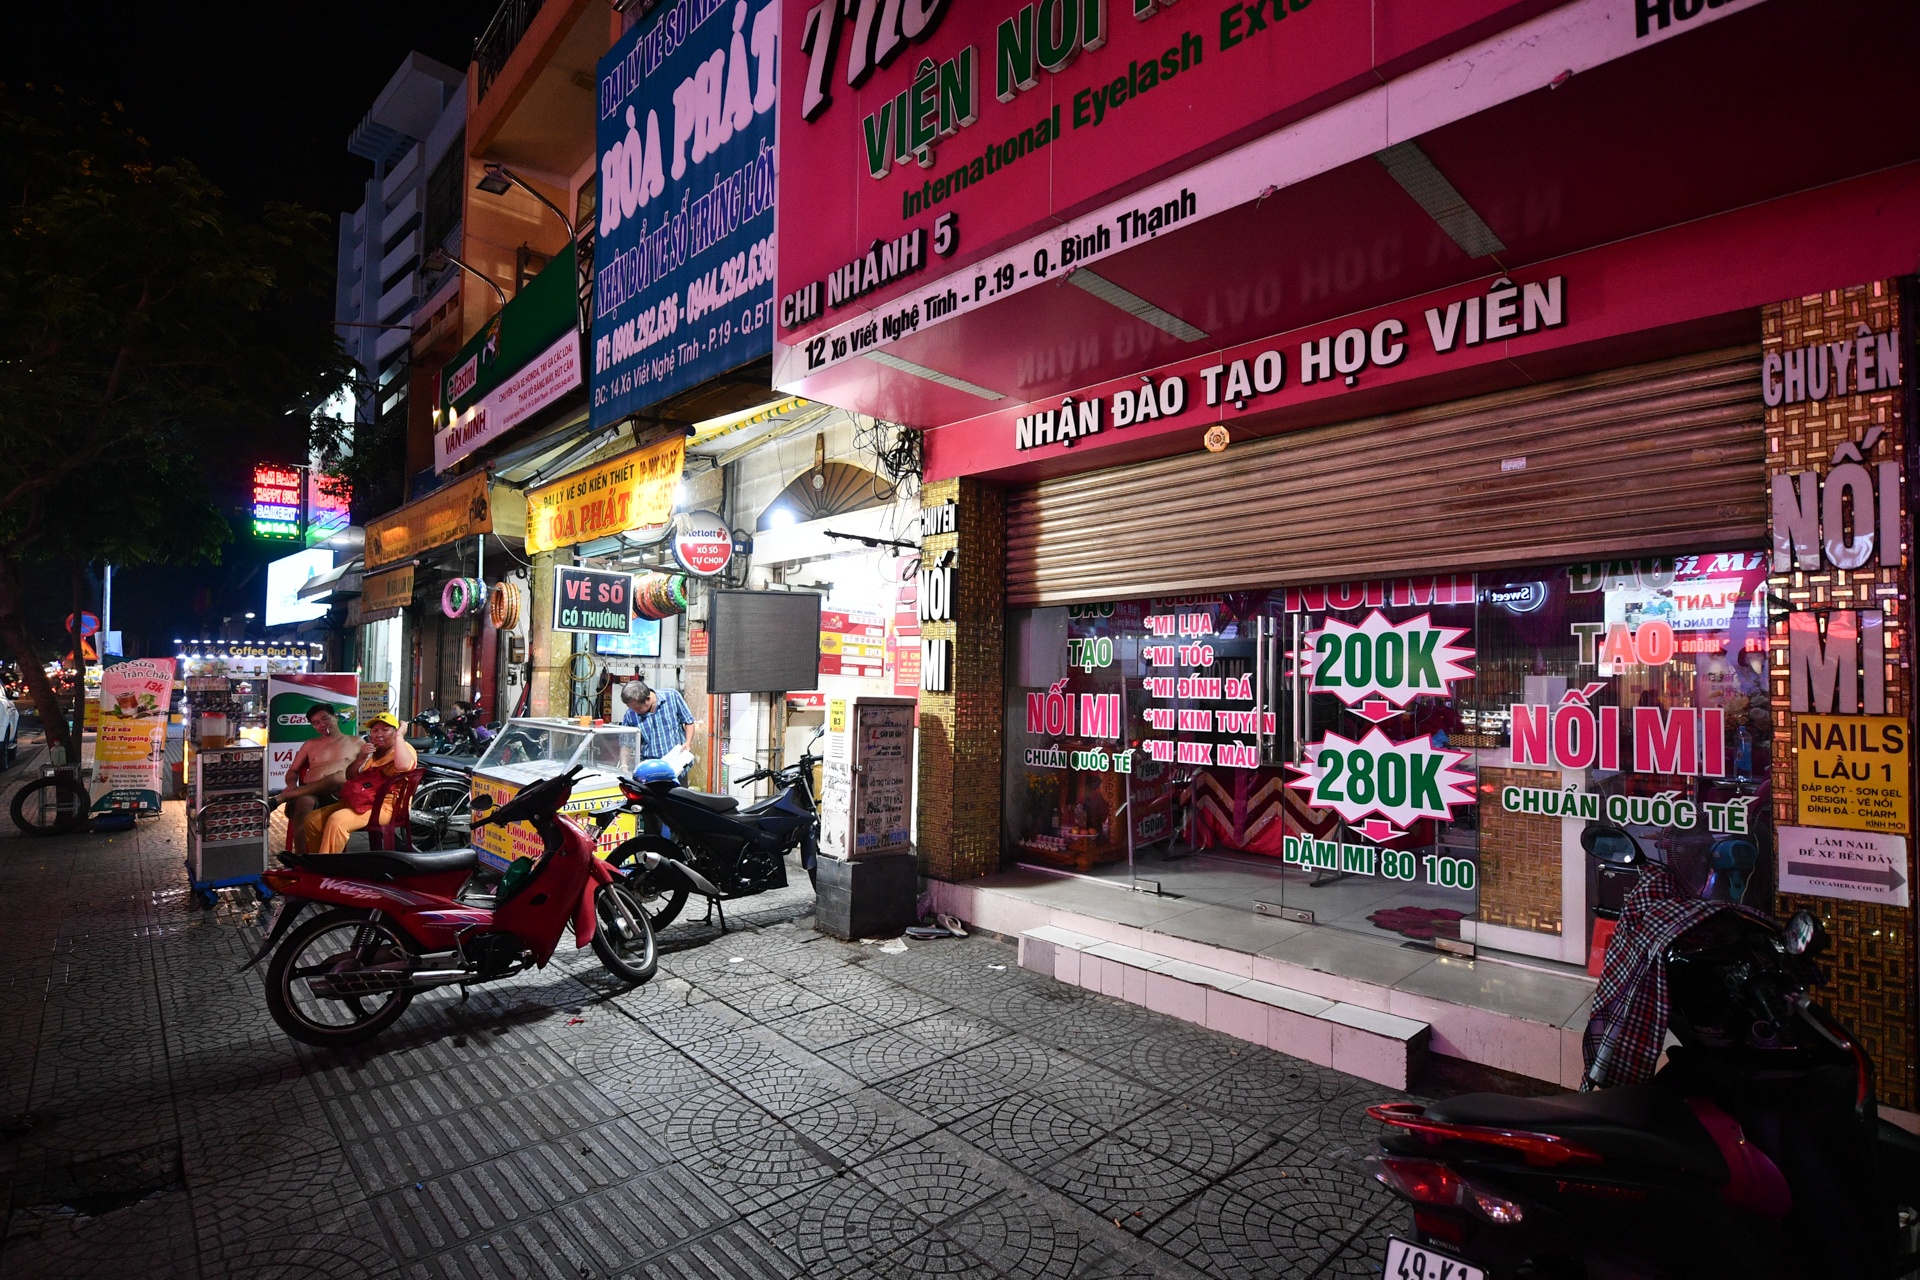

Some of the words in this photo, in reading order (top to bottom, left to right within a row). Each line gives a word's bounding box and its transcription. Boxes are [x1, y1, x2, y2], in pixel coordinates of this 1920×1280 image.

[602, 61, 624, 120] ĐẠI
[626, 36, 643, 97] LÝ
[645, 13, 664, 78] VÉ
[671, 0, 776, 181] PHÁT
[863, 45, 978, 179] VIỆN
[902, 104, 1060, 220] International
[1073, 31, 1203, 130] Eyelash
[597, 248, 629, 320] NHẬN
[652, 210, 670, 283] VÉ
[670, 187, 690, 272] SỐ
[780, 280, 824, 329] CHI
[827, 228, 926, 309] NHÁNH
[933, 211, 959, 257] 5
[804, 337, 826, 370] 12
[831, 335, 847, 361] Xô
[849, 318, 878, 349] Viết
[882, 304, 920, 338] Nghệ
[923, 289, 958, 322] Tĩnh
[974, 265, 1015, 302] P.19
[1117, 188, 1197, 237] Thạnh
[594, 384, 608, 407] ĐC:
[610, 379, 619, 399] 14
[620, 371, 632, 395] Xô
[633, 357, 649, 388] Viết
[651, 349, 676, 383] Nghệ
[677, 337, 699, 367] Tĩnh
[708, 319, 731, 352] P.19
[741, 297, 774, 335] Q.BT
[1015, 397, 1100, 451] NHẬN
[1111, 375, 1184, 428] ĐÀO
[1200, 350, 1284, 410] TẠO
[1301, 319, 1405, 386] HỌC
[1425, 276, 1566, 352] VIÊN
[1762, 323, 1900, 407] CHUYÊN
[454, 359, 476, 398] Castrol
[577, 475, 587, 496] SỐ
[589, 469, 607, 492] KIẾN
[610, 459, 635, 485] THIẾT
[256, 505, 296, 521] BAKERY
[579, 488, 631, 535] PHÁT
[1771, 425, 1900, 573] NỐI
[692, 556, 703, 565] TỰ
[704, 556, 723, 565] CHỌN
[566, 575, 591, 600] VÉ
[598, 579, 625, 604] SỐ
[917, 550, 951, 621] NỐI
[562, 605, 578, 626] CÓ
[582, 608, 626, 630] THƯỞNG
[1178, 613, 1213, 639] LỤA
[108, 662, 128, 673] Trà
[132, 660, 154, 669] Sữa
[229, 646, 264, 656] Coffee
[267, 647, 287, 656] And
[290, 647, 307, 656] Tea
[921, 639, 947, 691] MI
[1067, 636, 1114, 673] TẠO
[1179, 641, 1214, 667] TÓC
[1315, 630, 1442, 688] 200K
[1570, 621, 1675, 675] TẠO
[1789, 610, 1884, 714] MI
[121, 670, 144, 679] Trân
[1177, 672, 1222, 700] ĐÍNH
[1225, 672, 1253, 700] ĐÁ
[1026, 678, 1076, 737] NỐI
[1080, 693, 1120, 739] MI
[1178, 709, 1213, 732] KIM
[1510, 682, 1620, 772] NỐI
[1632, 706, 1726, 777] MI
[1801, 723, 1904, 754] NAILS
[1024, 744, 1067, 769] CHUẨN
[1070, 746, 1109, 772] QUỐC
[1113, 748, 1136, 773] TẾ
[1177, 741, 1213, 766] MIX
[1217, 740, 1261, 770] MÀU
[1813, 755, 1870, 780] LẦU
[1880, 764, 1891, 782] 1
[1317, 749, 1445, 811] 280K
[1825, 785, 1846, 794] BỘT
[1881, 789, 1902, 798] GEL
[563, 803, 580, 812] ĐẠI
[585, 800, 596, 810] LÝ
[1502, 783, 1600, 821] CHUẨN
[1606, 790, 1697, 829] QUỐC
[1703, 796, 1759, 834] TẾ
[1810, 795, 1847, 804] DESIGN
[1858, 809, 1897, 818] CHARM
[1283, 832, 1339, 872] DẶM
[1341, 843, 1375, 876] MI
[1381, 849, 1416, 882] 80
[1423, 854, 1476, 890] 100
[1814, 837, 1842, 847] LÀM
[1846, 840, 1878, 850] NAIL
[1818, 850, 1835, 859] XE
[1839, 850, 1864, 861] BÊN
[1821, 881, 1855, 890] CAMERA
[1429, 1238, 1460, 1253] HONDA
